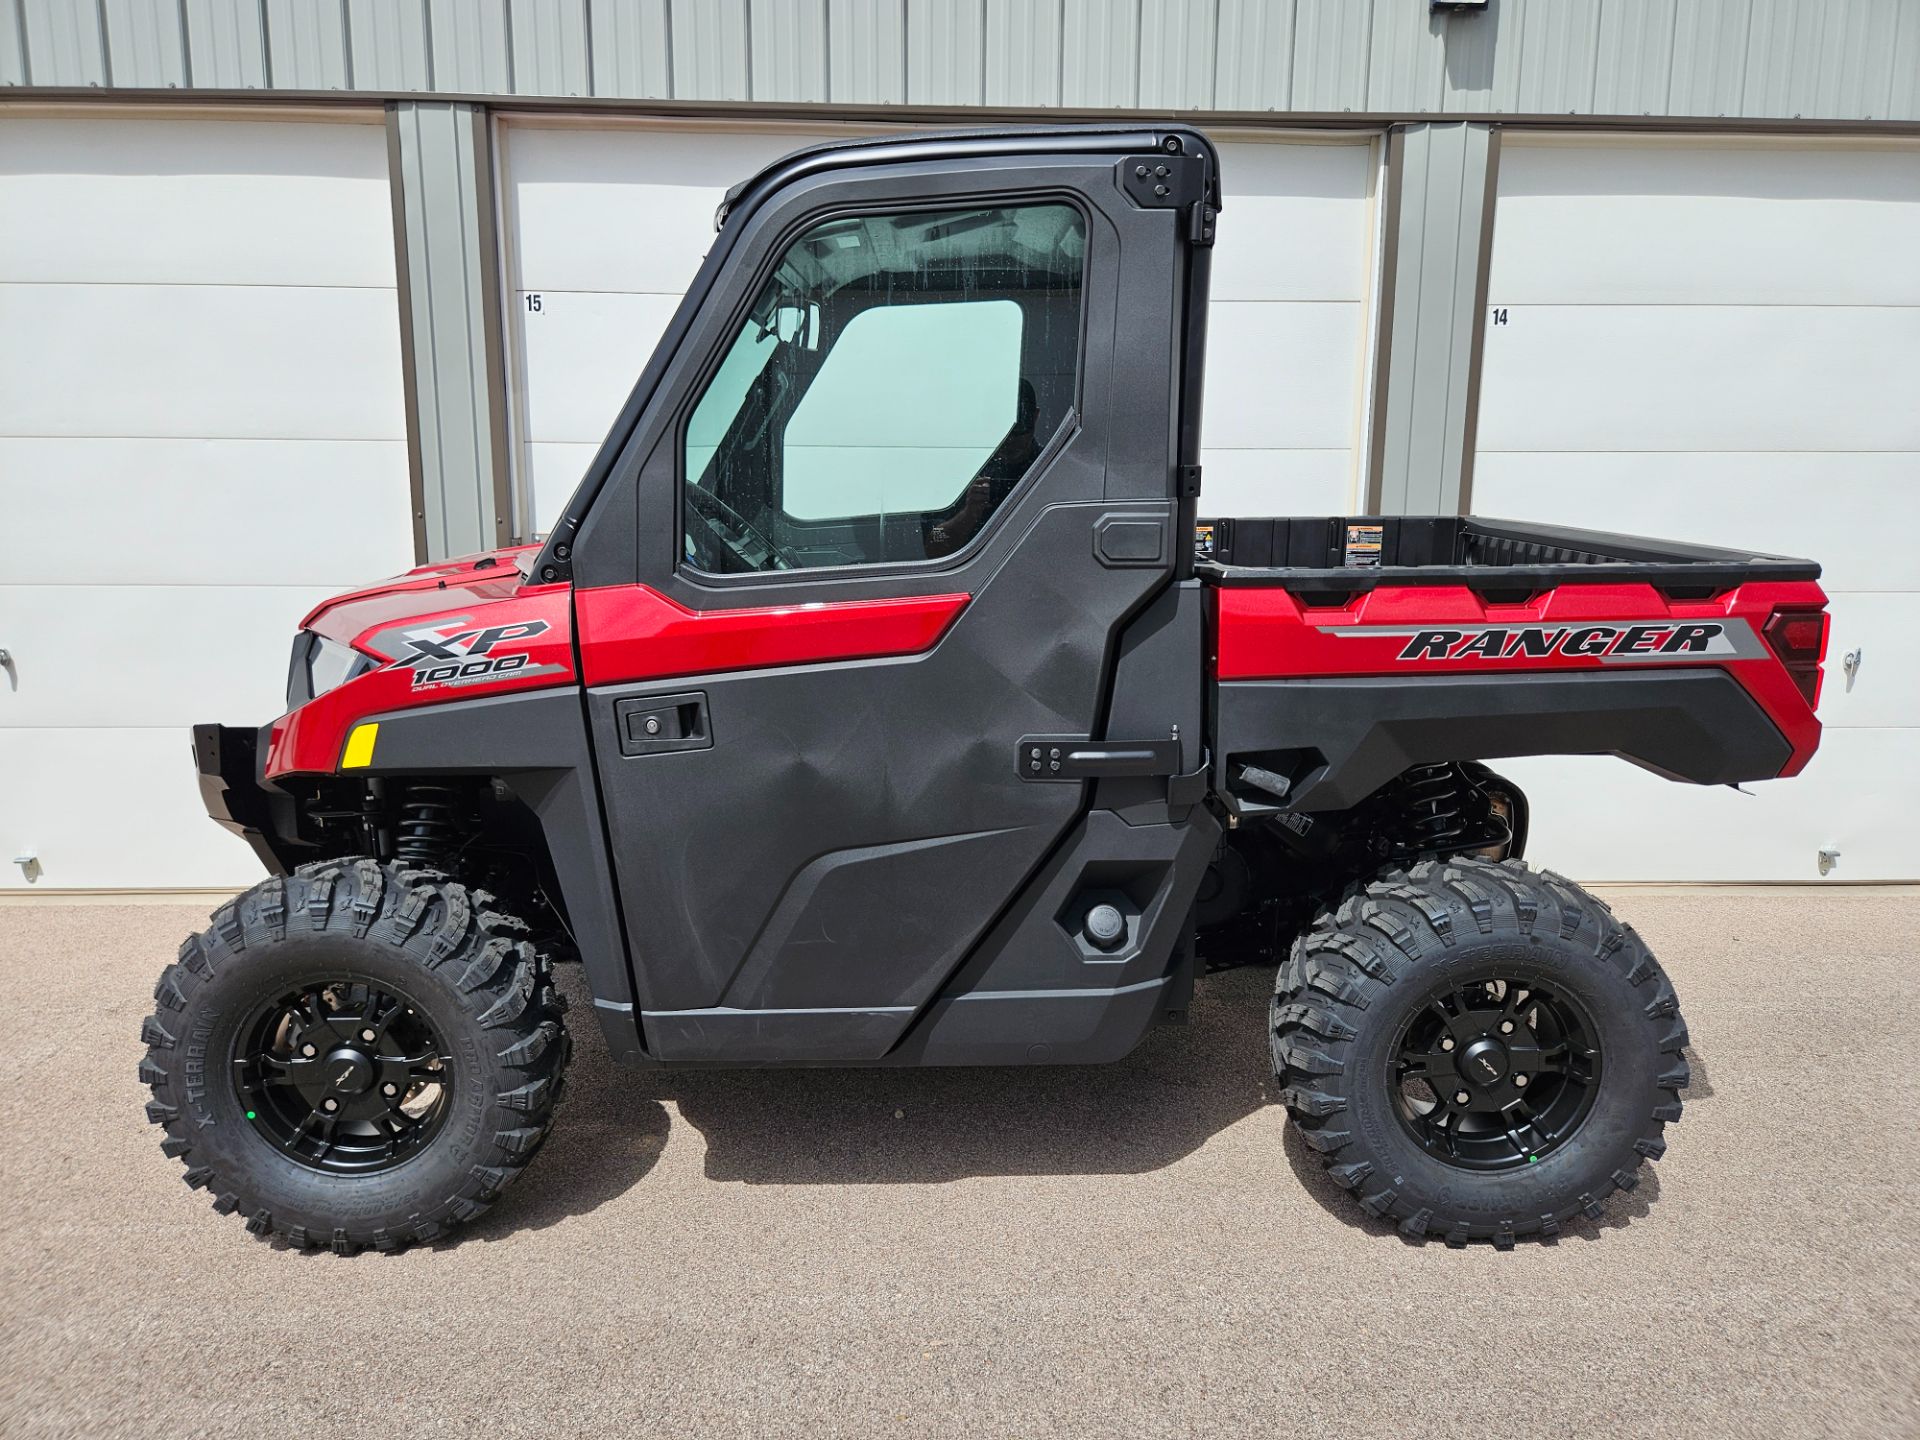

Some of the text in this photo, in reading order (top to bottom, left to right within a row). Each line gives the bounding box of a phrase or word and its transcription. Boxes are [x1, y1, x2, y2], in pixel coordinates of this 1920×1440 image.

[526, 294, 542, 311] 15
[1493, 308, 1508, 325] 14
[378, 619, 552, 673] XP
[1396, 622, 1725, 660] RANGER
[411, 653, 529, 687] 1000
[411, 670, 522, 692] DUAL OVERHEAD CAM
